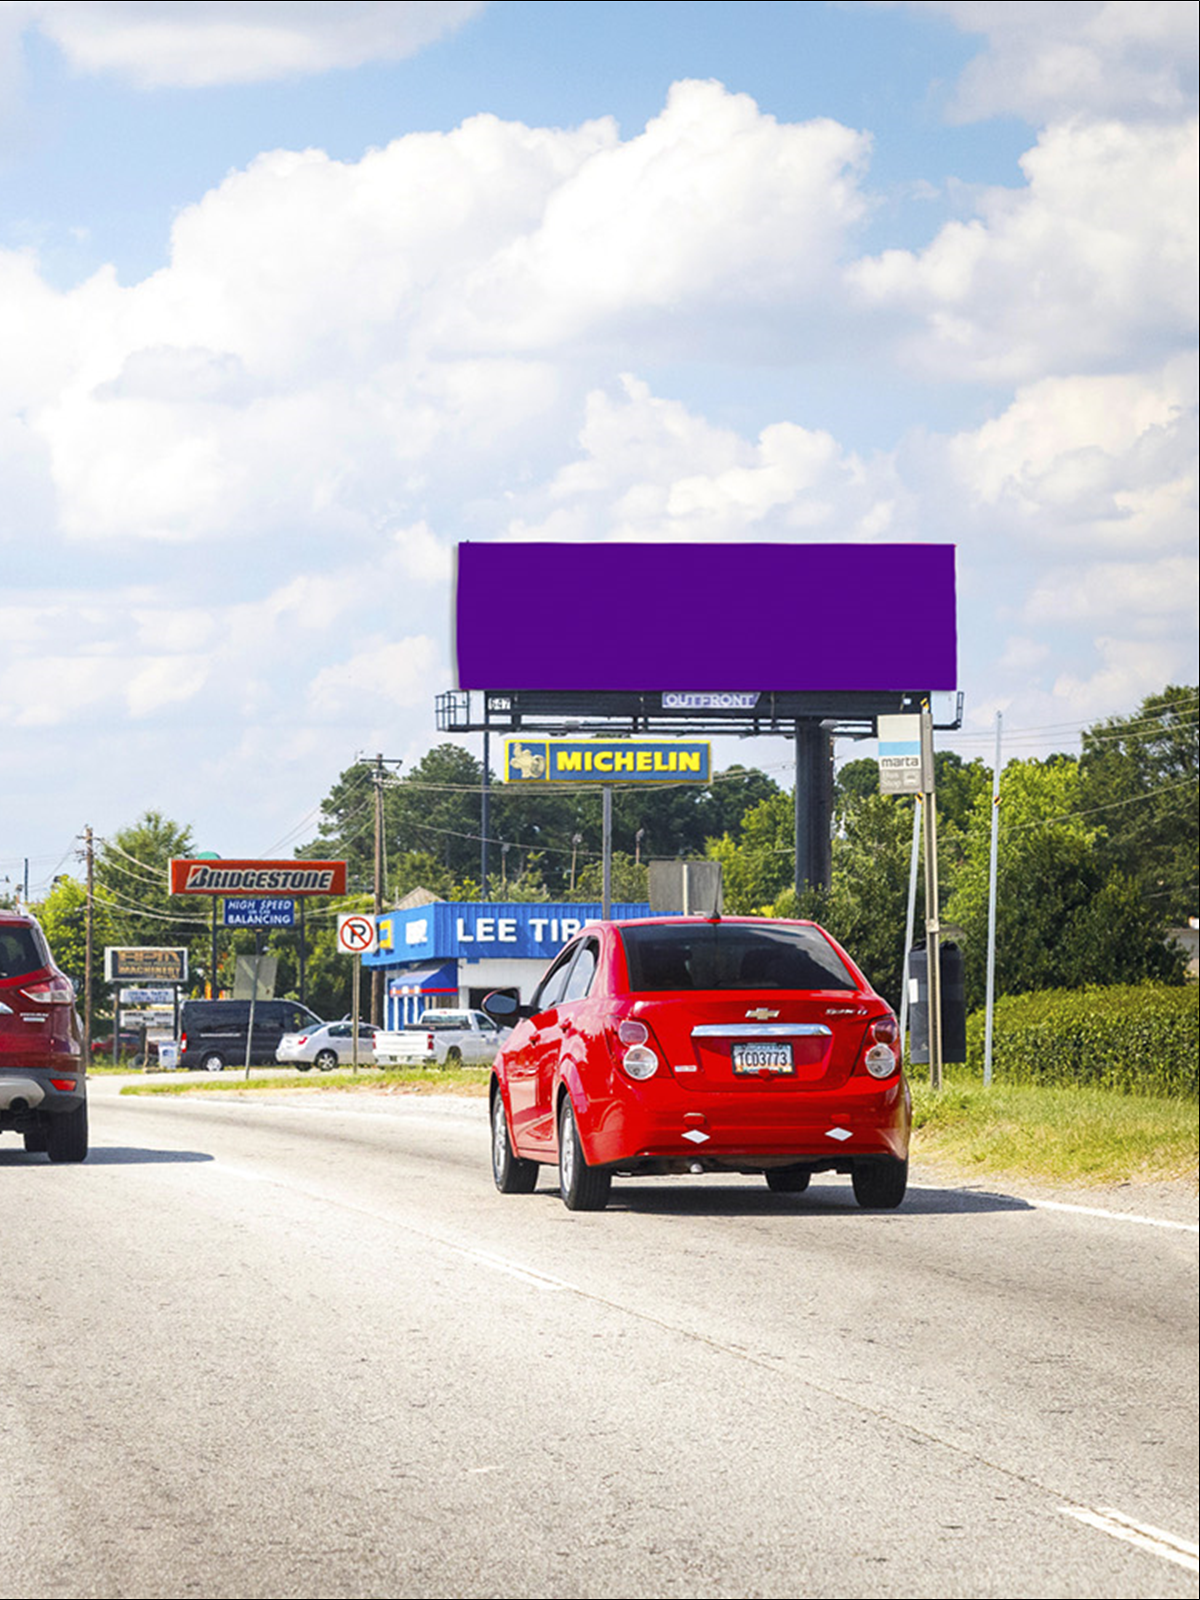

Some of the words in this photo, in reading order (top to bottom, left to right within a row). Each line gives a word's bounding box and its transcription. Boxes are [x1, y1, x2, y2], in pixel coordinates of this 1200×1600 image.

[666, 693, 755, 706] OUTFRONT
[557, 751, 700, 772] MICHELIN
[881, 756, 919, 767] marta
[185, 865, 335, 891] BRIDGESTONE
[228, 900, 256, 910] HIGH
[260, 900, 292, 910] SPEED
[228, 915, 291, 924] BALANCING
[456, 917, 518, 943] LEE
[117, 966, 180, 975] MACHINERY
